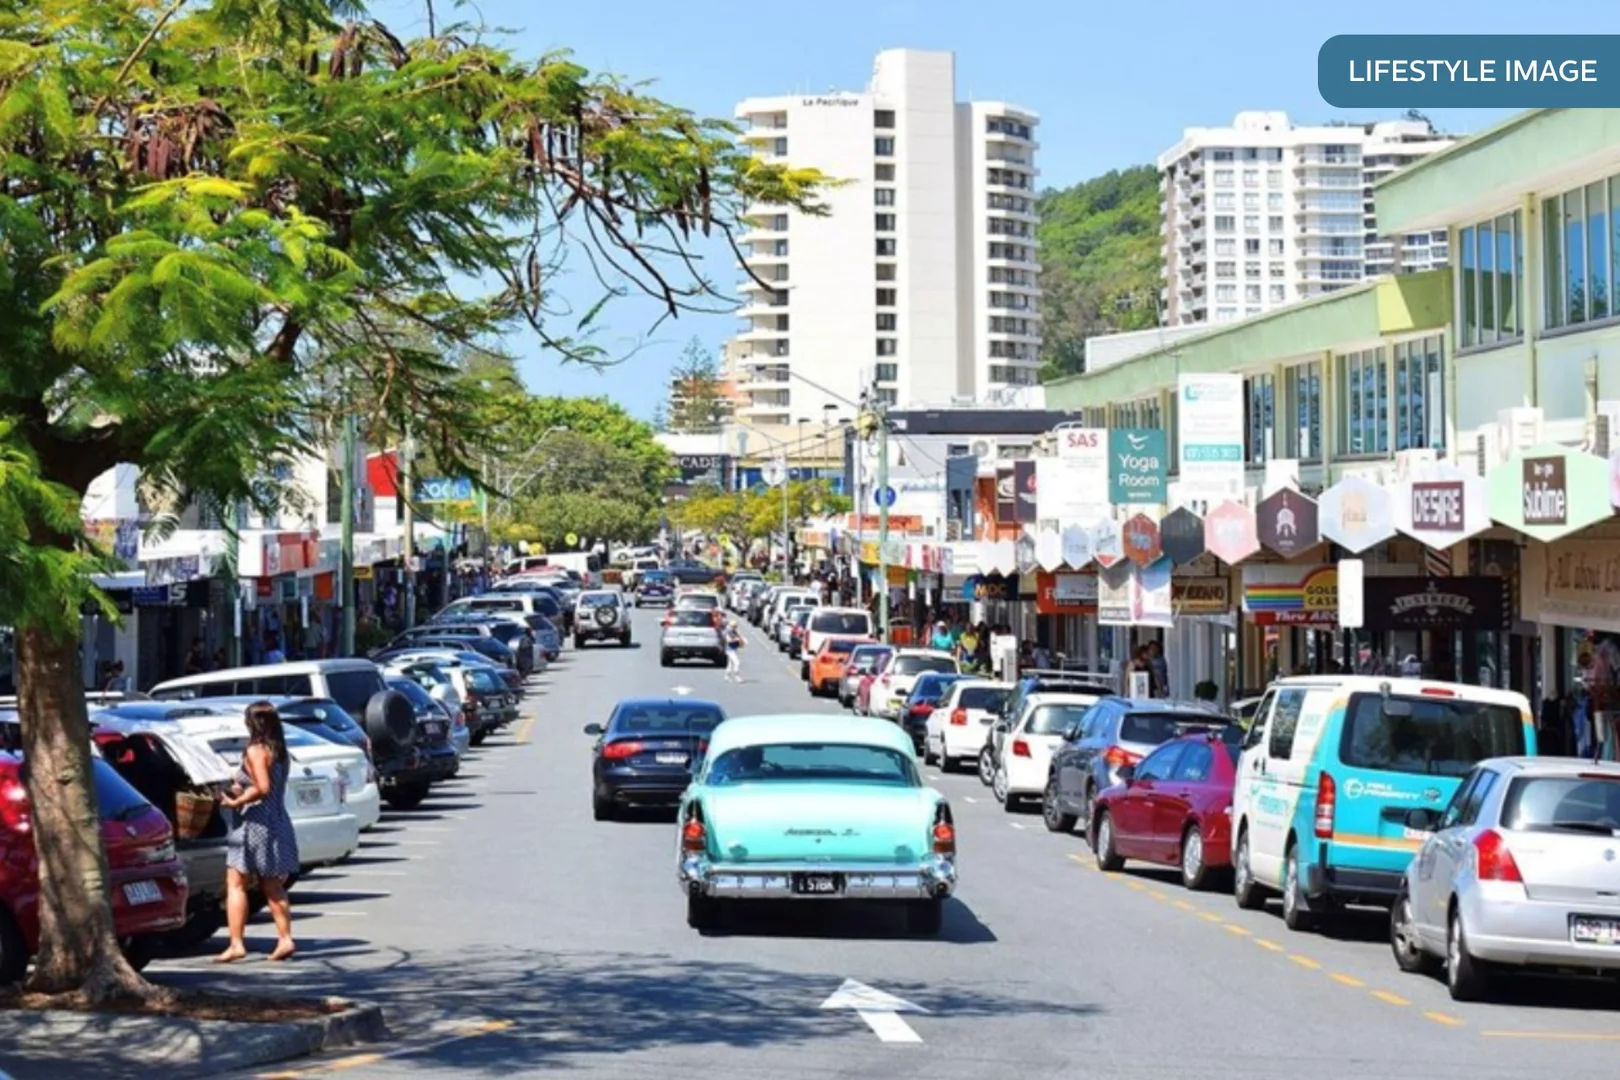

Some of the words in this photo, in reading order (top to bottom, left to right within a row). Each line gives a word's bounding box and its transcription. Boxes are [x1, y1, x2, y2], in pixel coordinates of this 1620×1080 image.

[1067, 432, 1098, 448] SAS
[1118, 453, 1159, 473] Yoga
[1118, 473, 1160, 487] Room
[1413, 488, 1461, 526] DESIRE
